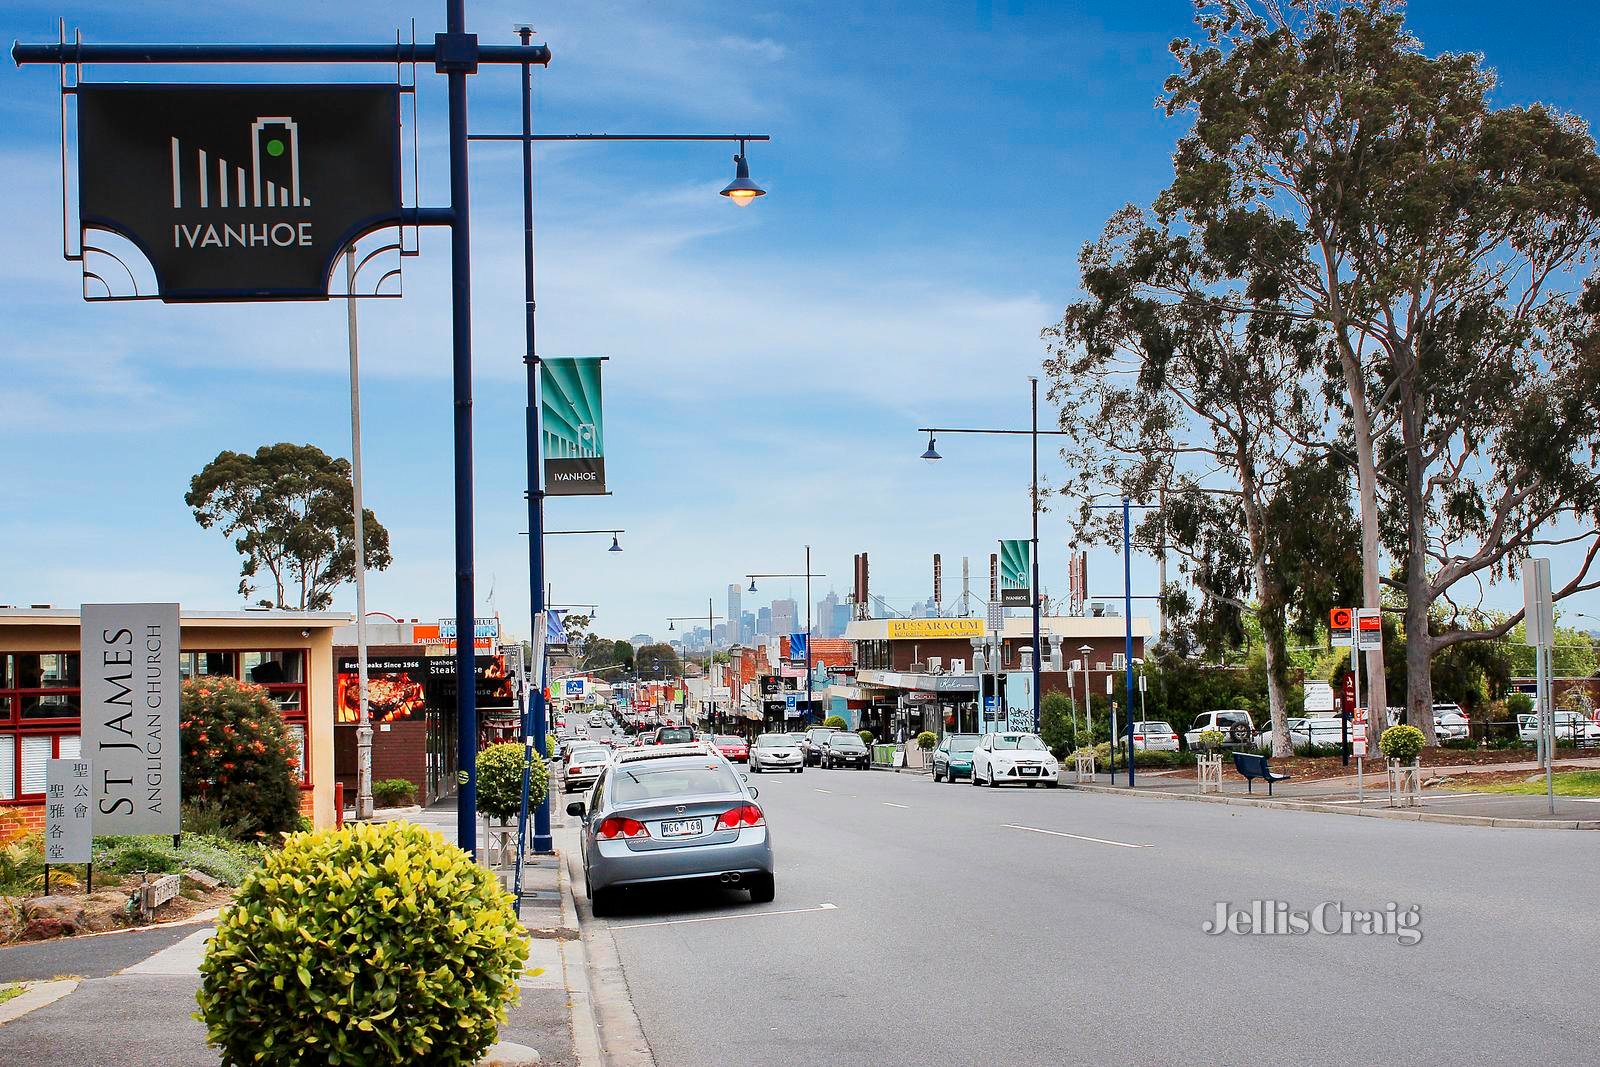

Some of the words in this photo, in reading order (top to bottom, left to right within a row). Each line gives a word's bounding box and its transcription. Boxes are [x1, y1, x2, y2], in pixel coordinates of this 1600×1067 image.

[174, 222, 313, 248] IVANHOE
[554, 472, 597, 481] IVANHOE
[99, 628, 144, 754] JAMES
[147, 624, 162, 709] CHURCH
[73, 762, 89, 819] 聖公會
[100, 769, 134, 816] ST
[147, 714, 163, 814] ANGLICAN
[49, 783, 65, 860] 聖雅各堂
[662, 821, 680, 833] WGG
[685, 820, 701, 831] 168
